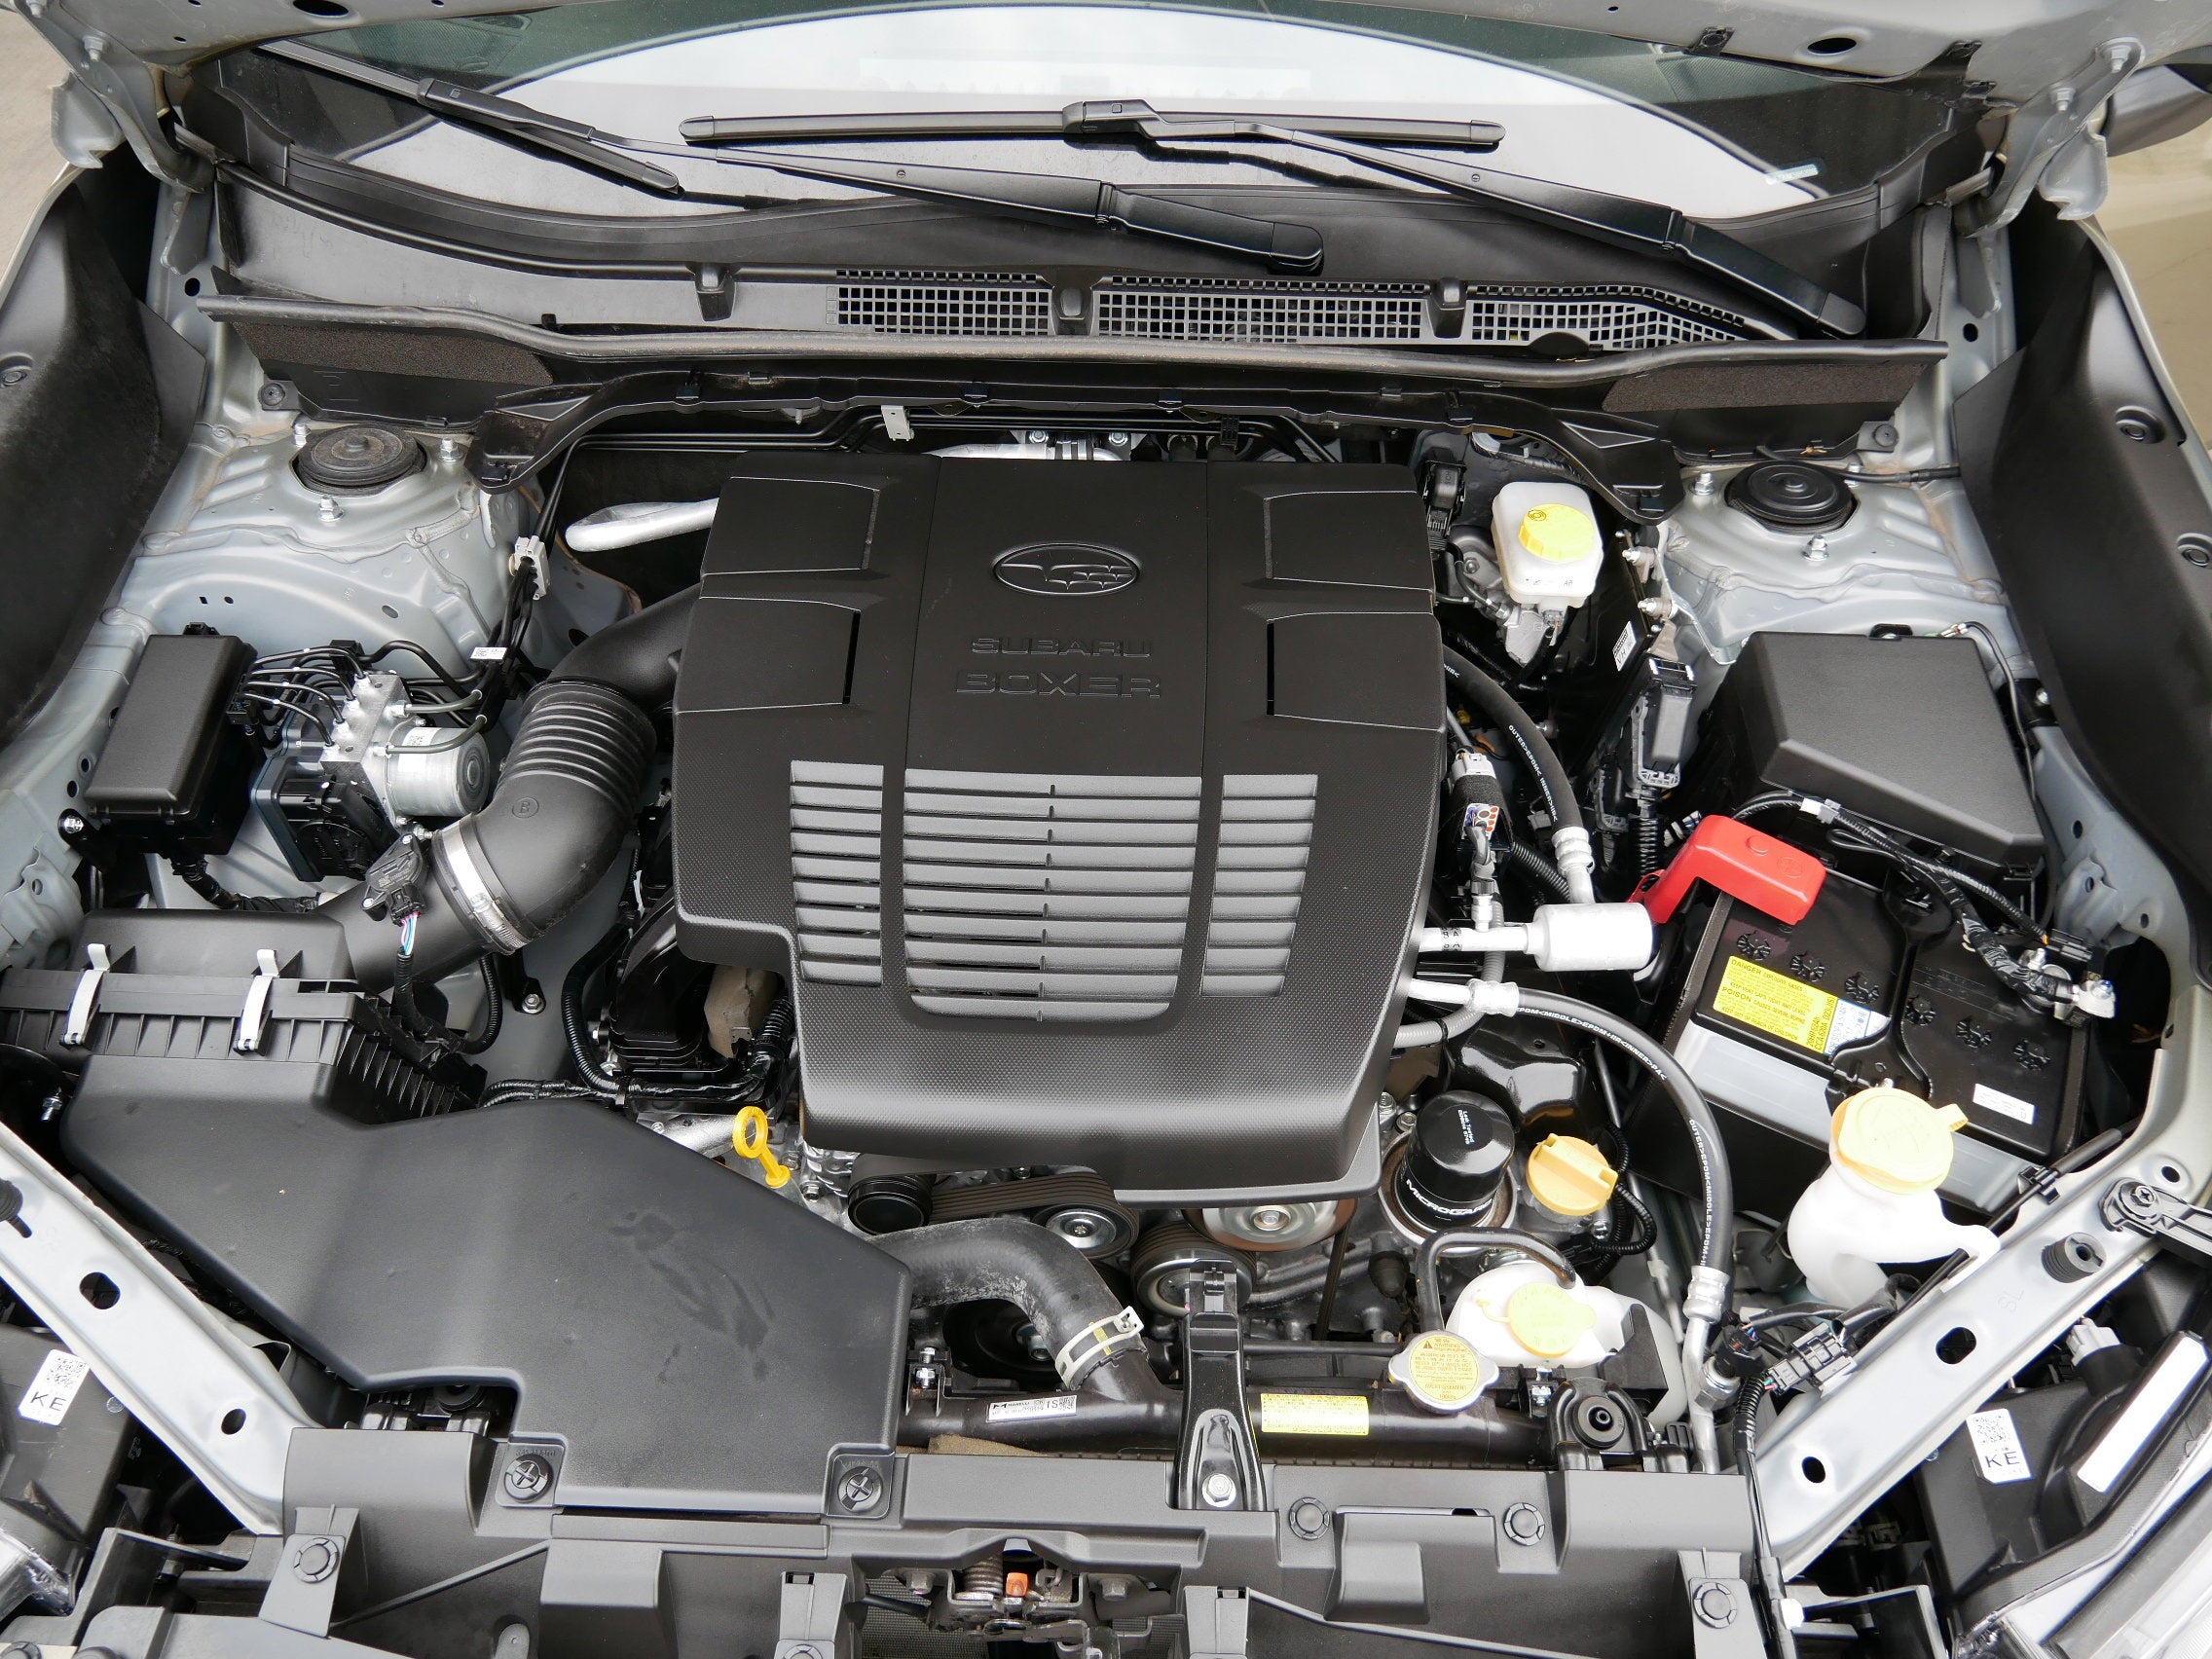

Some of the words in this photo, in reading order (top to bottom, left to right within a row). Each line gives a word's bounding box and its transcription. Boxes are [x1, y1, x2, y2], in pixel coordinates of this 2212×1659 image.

[971, 637, 1153, 658] SUBARU
[955, 670, 1161, 699] BOXER
[1731, 959, 1761, 975] DANGER
[1721, 986, 1751, 1002] POISON
[30, 1391, 66, 1412] KE
[1985, 1451, 2020, 1468] KE
